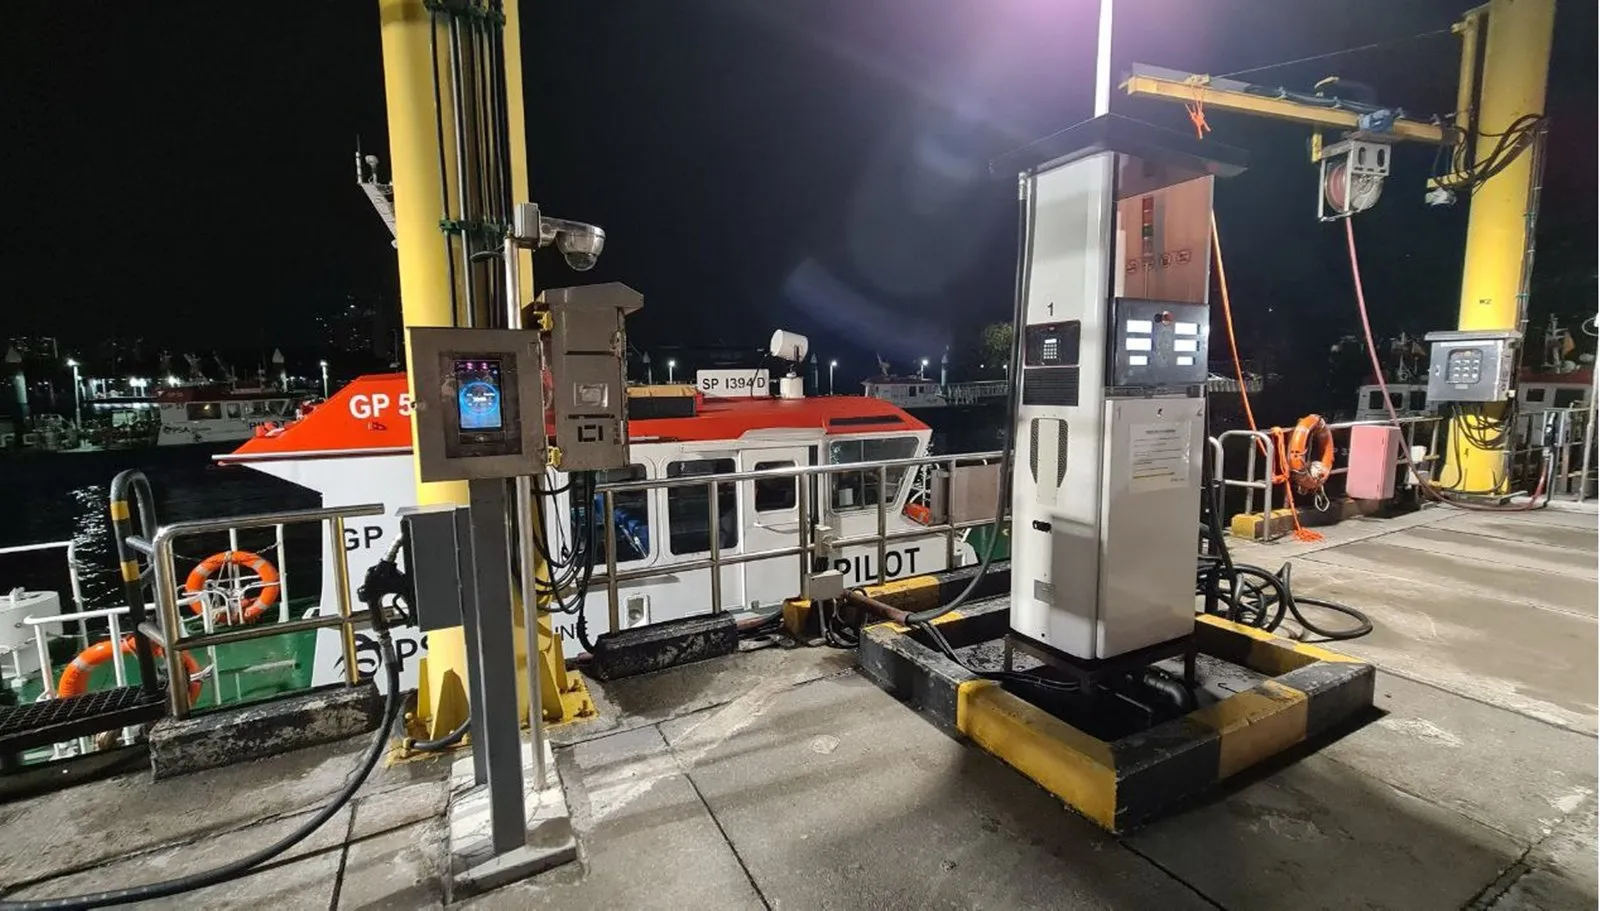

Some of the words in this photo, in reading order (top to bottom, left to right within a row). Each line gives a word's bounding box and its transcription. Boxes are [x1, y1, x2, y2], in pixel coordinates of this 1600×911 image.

[1047, 302, 1053, 316] 1
[702, 378, 719, 390] SP
[725, 377, 753, 389] 1394
[757, 377, 766, 389] D
[350, 393, 390, 419] GP
[344, 526, 383, 551] GP
[834, 547, 920, 583] PILOT
